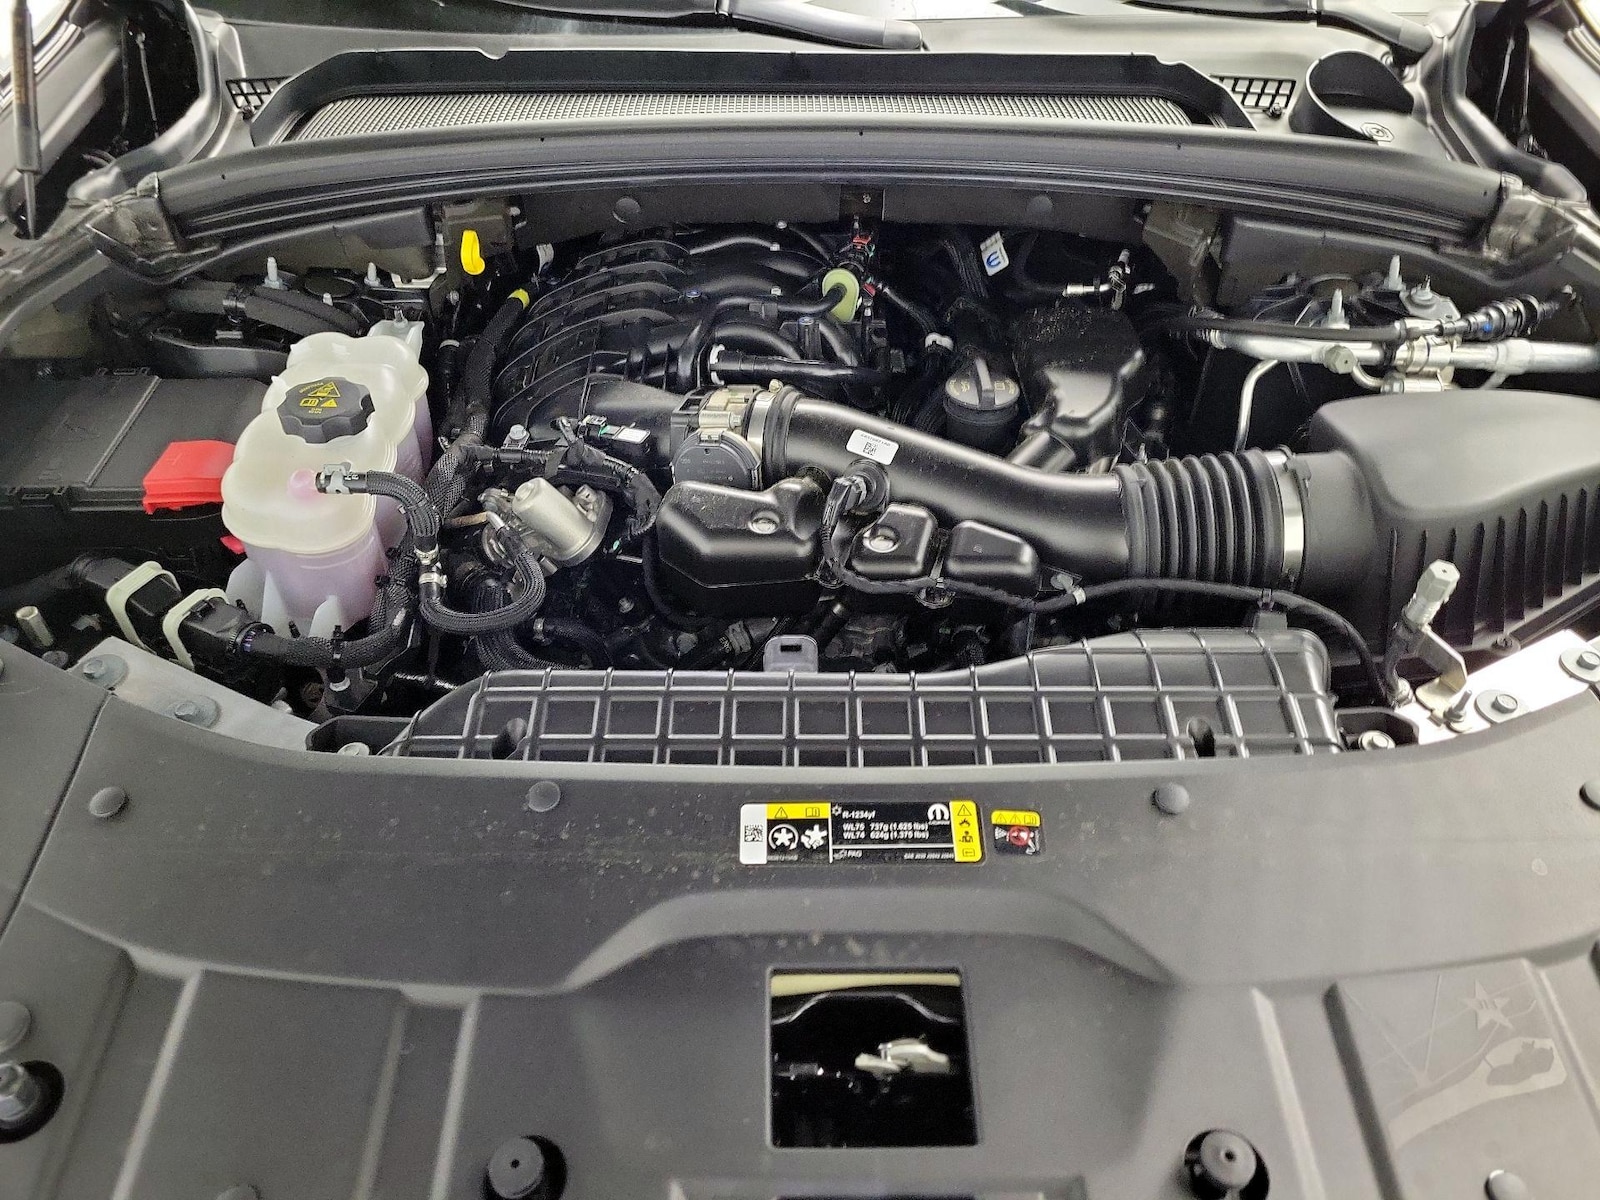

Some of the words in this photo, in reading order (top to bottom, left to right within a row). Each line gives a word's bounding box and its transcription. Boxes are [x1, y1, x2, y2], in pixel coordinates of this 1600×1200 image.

[842, 809, 876, 820] R-1234yf
[869, 821, 889, 832] 737g
[913, 821, 929, 831] lbs)
[843, 831, 866, 839] WL74
[870, 831, 890, 840] 624g
[914, 830, 929, 840] lbs)
